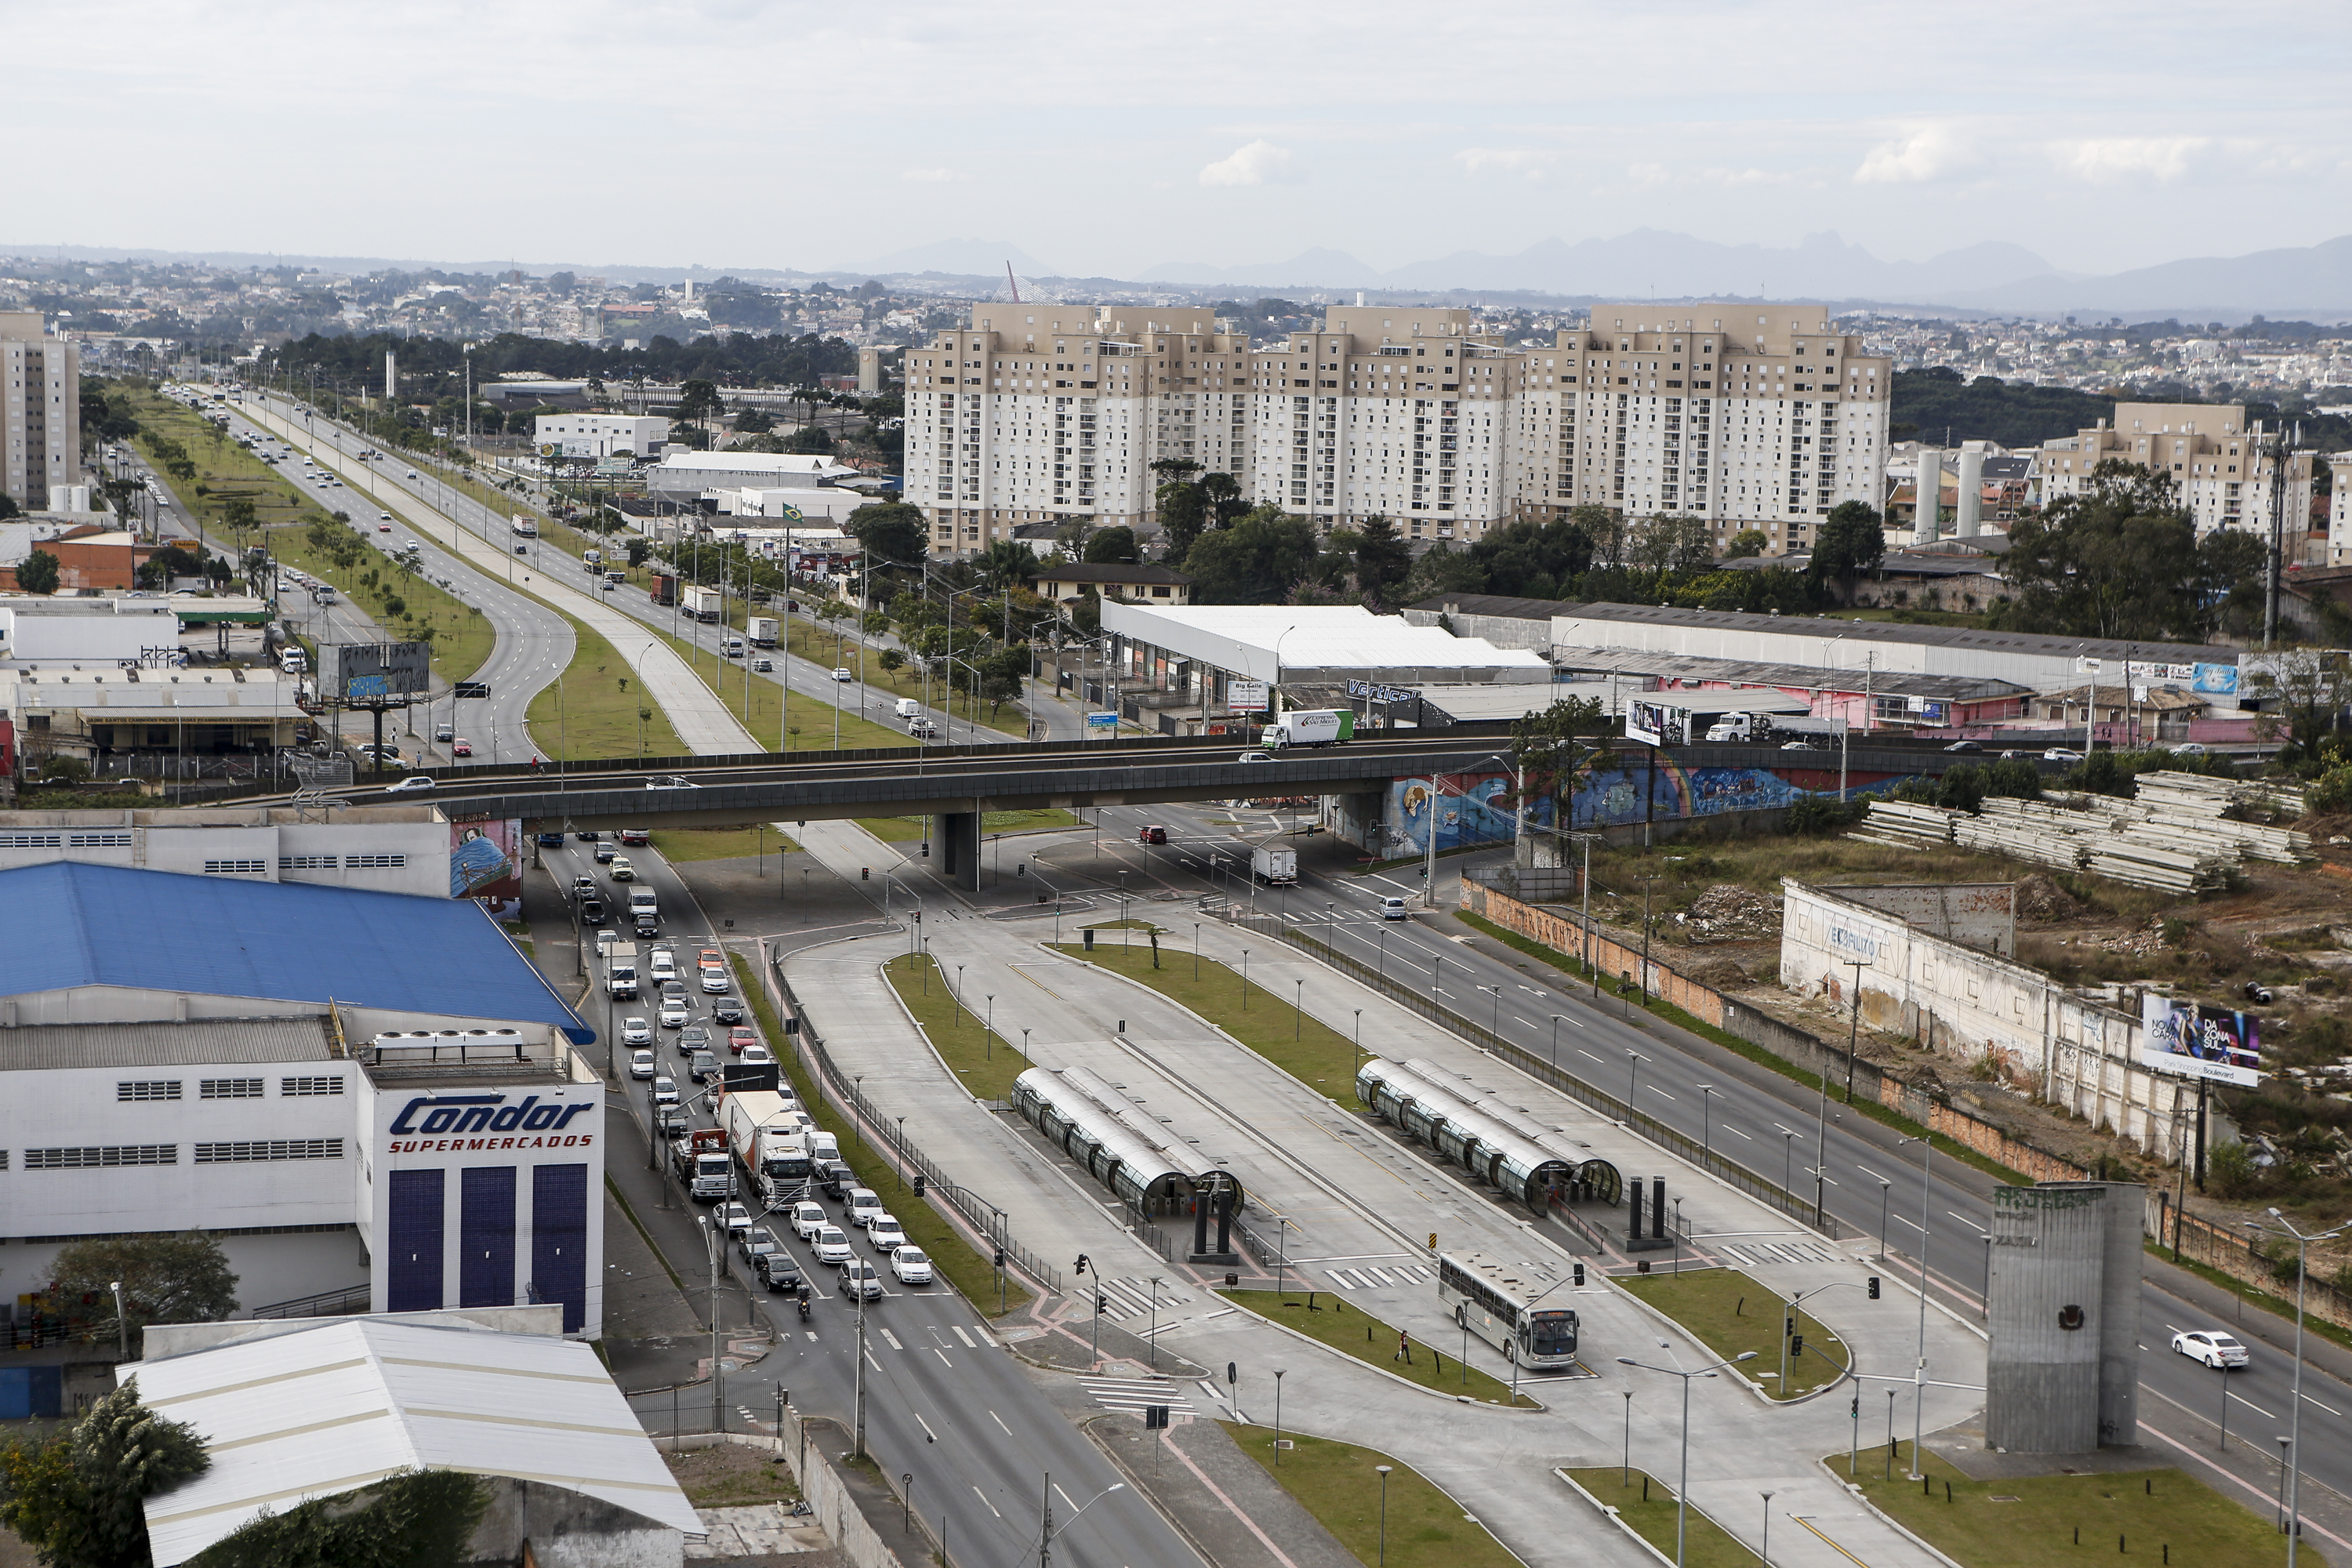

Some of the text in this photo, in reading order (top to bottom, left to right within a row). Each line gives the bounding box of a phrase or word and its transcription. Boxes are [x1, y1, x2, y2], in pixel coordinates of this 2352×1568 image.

[1348, 679, 1416, 702] Vertical
[2151, 1019, 2176, 1031] NOVA
[2204, 1018, 2217, 1030] DA
[2151, 1029, 2176, 1041] CARA
[2204, 1029, 2230, 1044] ZONA
[2203, 1038, 2223, 1051] SUL
[2203, 1066, 2234, 1080] Boulevard
[389, 1094, 594, 1134] Condor
[389, 1134, 593, 1153] SUPERMERCADOS
